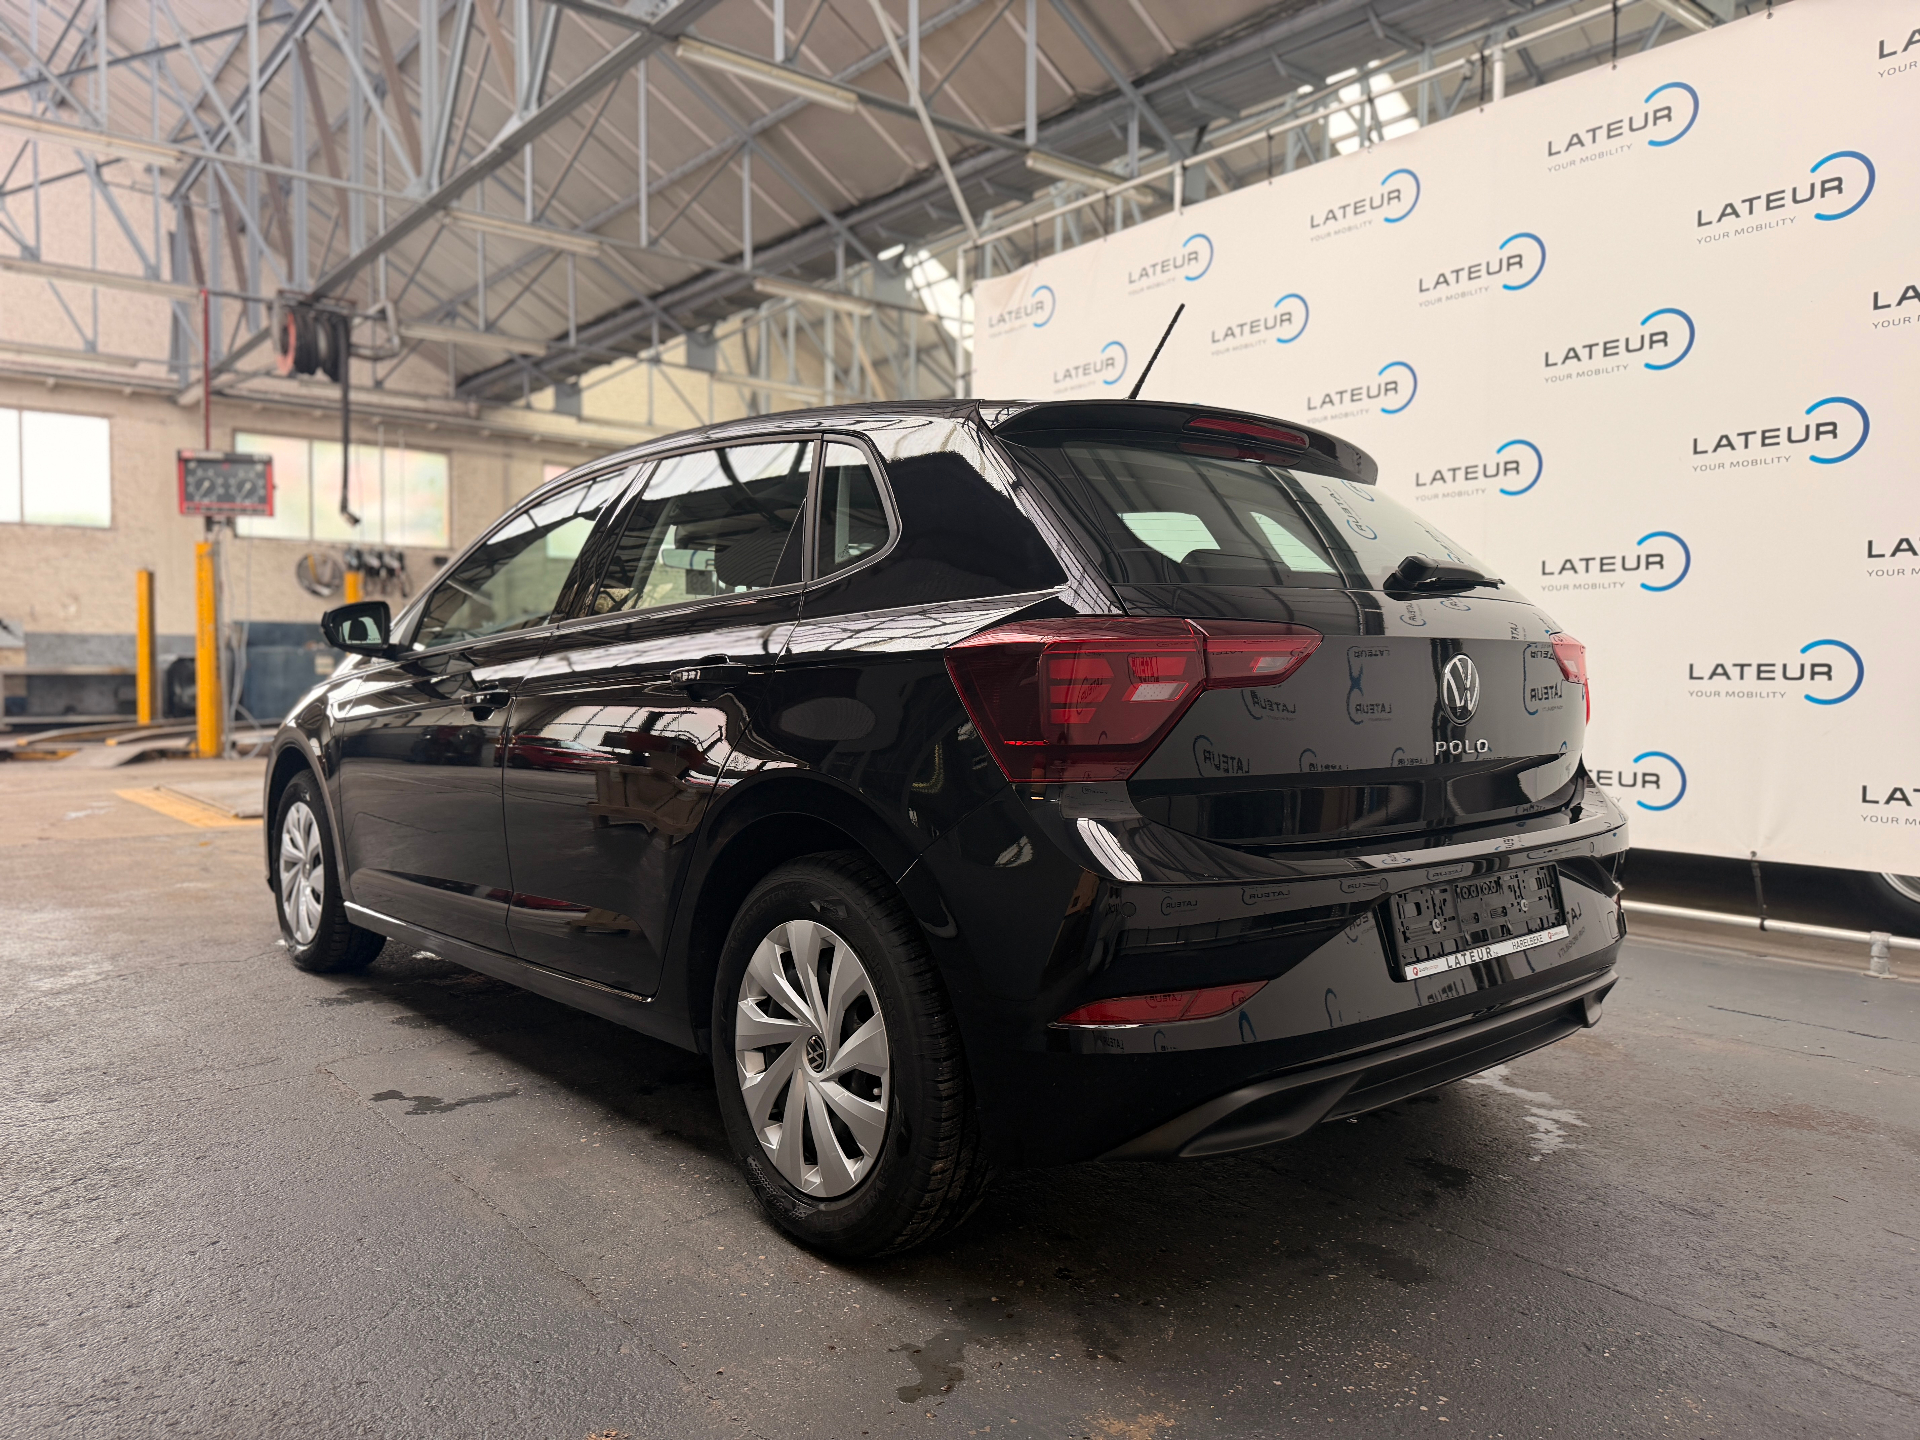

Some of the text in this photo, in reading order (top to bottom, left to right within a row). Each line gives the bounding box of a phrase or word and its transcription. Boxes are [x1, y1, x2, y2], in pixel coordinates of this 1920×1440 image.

[1878, 61, 1918, 78] YOUR
[1547, 105, 1673, 157] LATEUR
[1547, 143, 1633, 173] YOUR MOBILITY
[1310, 188, 1402, 229] LATEUR
[1697, 176, 1844, 228] LATEUR
[1696, 216, 1797, 245] YOUR MOBILITY
[1128, 251, 1200, 285] LATEUR
[1419, 253, 1524, 293] LATEUR
[1418, 285, 1490, 308] YOUR MOBILITY
[988, 300, 1045, 328] LATEUR
[1872, 316, 1912, 329] YOUR
[1211, 312, 1293, 344] LATEUR
[1544, 330, 1669, 368] LATEUR
[1054, 356, 1116, 384] LATEUR
[1544, 363, 1630, 383] YOUR MOBILITY
[1306, 380, 1399, 411] LATEUR
[1692, 421, 1838, 455] LATEUR
[1415, 459, 1521, 487] LATEUR
[1692, 455, 1792, 472] YOUR MOBILITY
[1415, 487, 1487, 503] YOUR MOBILITY
[1541, 553, 1665, 576] LATEUR
[1867, 568, 1906, 577] YOUR
[1541, 581, 1626, 592] YOUR MOBILITY
[1688, 663, 1833, 681] LATEUR
[1688, 690, 1787, 699] YOUR MOBILITY
[1435, 739, 1489, 756] POLO
[1588, 769, 1660, 789] EUR
[1861, 814, 1899, 825] YOUR
[1511, 934, 1544, 950] HARELBEKE
[1446, 947, 1493, 969] LATEUR
